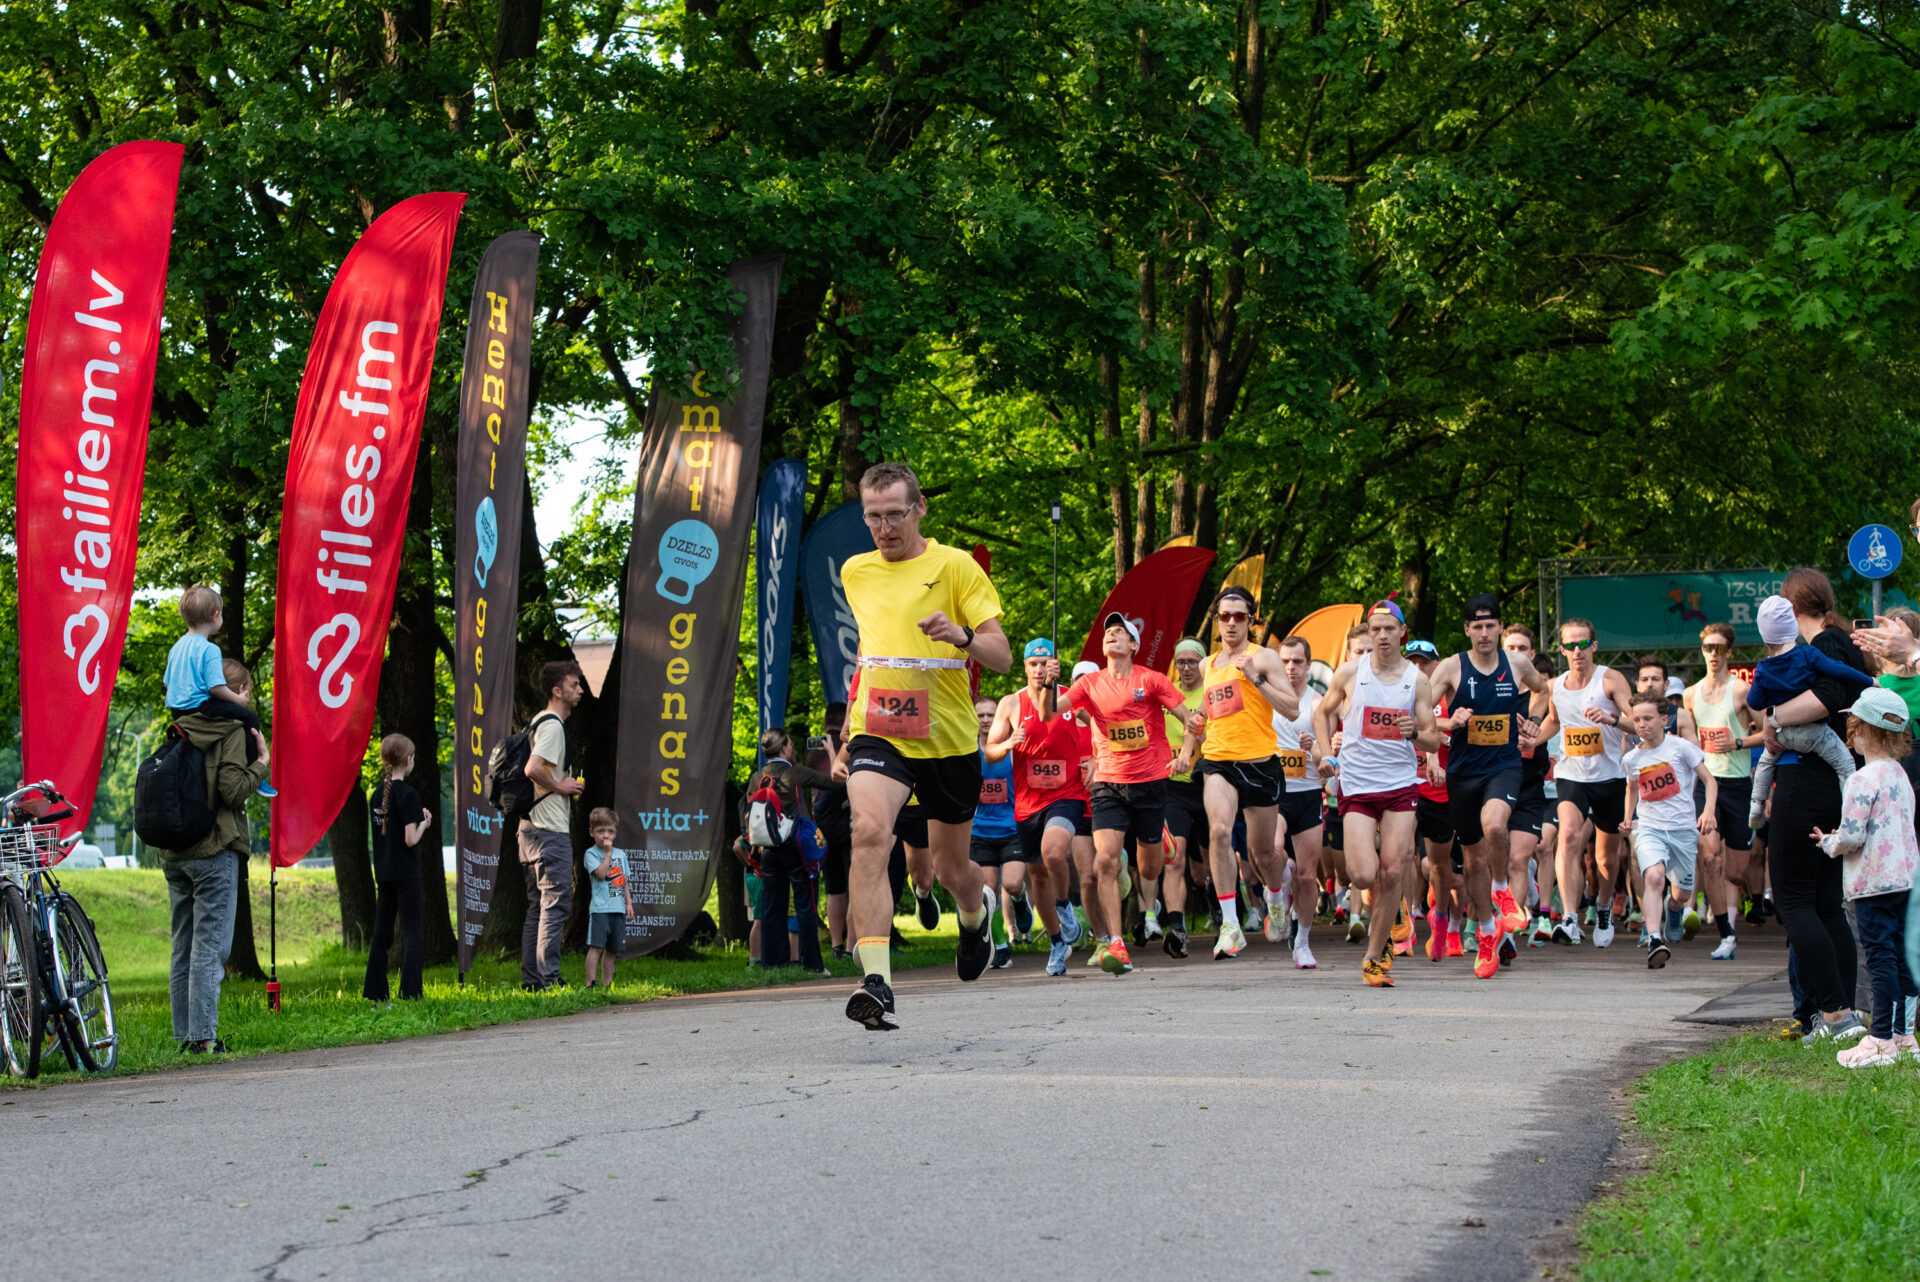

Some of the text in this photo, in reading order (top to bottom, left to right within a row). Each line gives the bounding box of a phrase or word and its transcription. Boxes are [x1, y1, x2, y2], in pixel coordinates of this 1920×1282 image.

[60, 269, 124, 592] failiem.lv
[680, 370, 721, 511] emat
[317, 320, 398, 594] files.fm
[667, 536, 712, 560] DZELZS
[1146, 629, 1163, 668] studios
[471, 597, 487, 795] genas
[659, 613, 696, 796] genas
[1207, 685, 1234, 705] 955
[877, 696, 919, 717] 124
[1109, 725, 1146, 742] 1555
[1475, 719, 1504, 732] 745
[1567, 732, 1601, 746] 1307
[1032, 763, 1061, 776] 948
[1642, 772, 1676, 794] 1108
[638, 807, 709, 831] vita+
[627, 871, 682, 883] GĀTINĀTĀJS
[628, 861, 650, 872] TURA
[632, 893, 676, 905] NVĒRTĪGU
